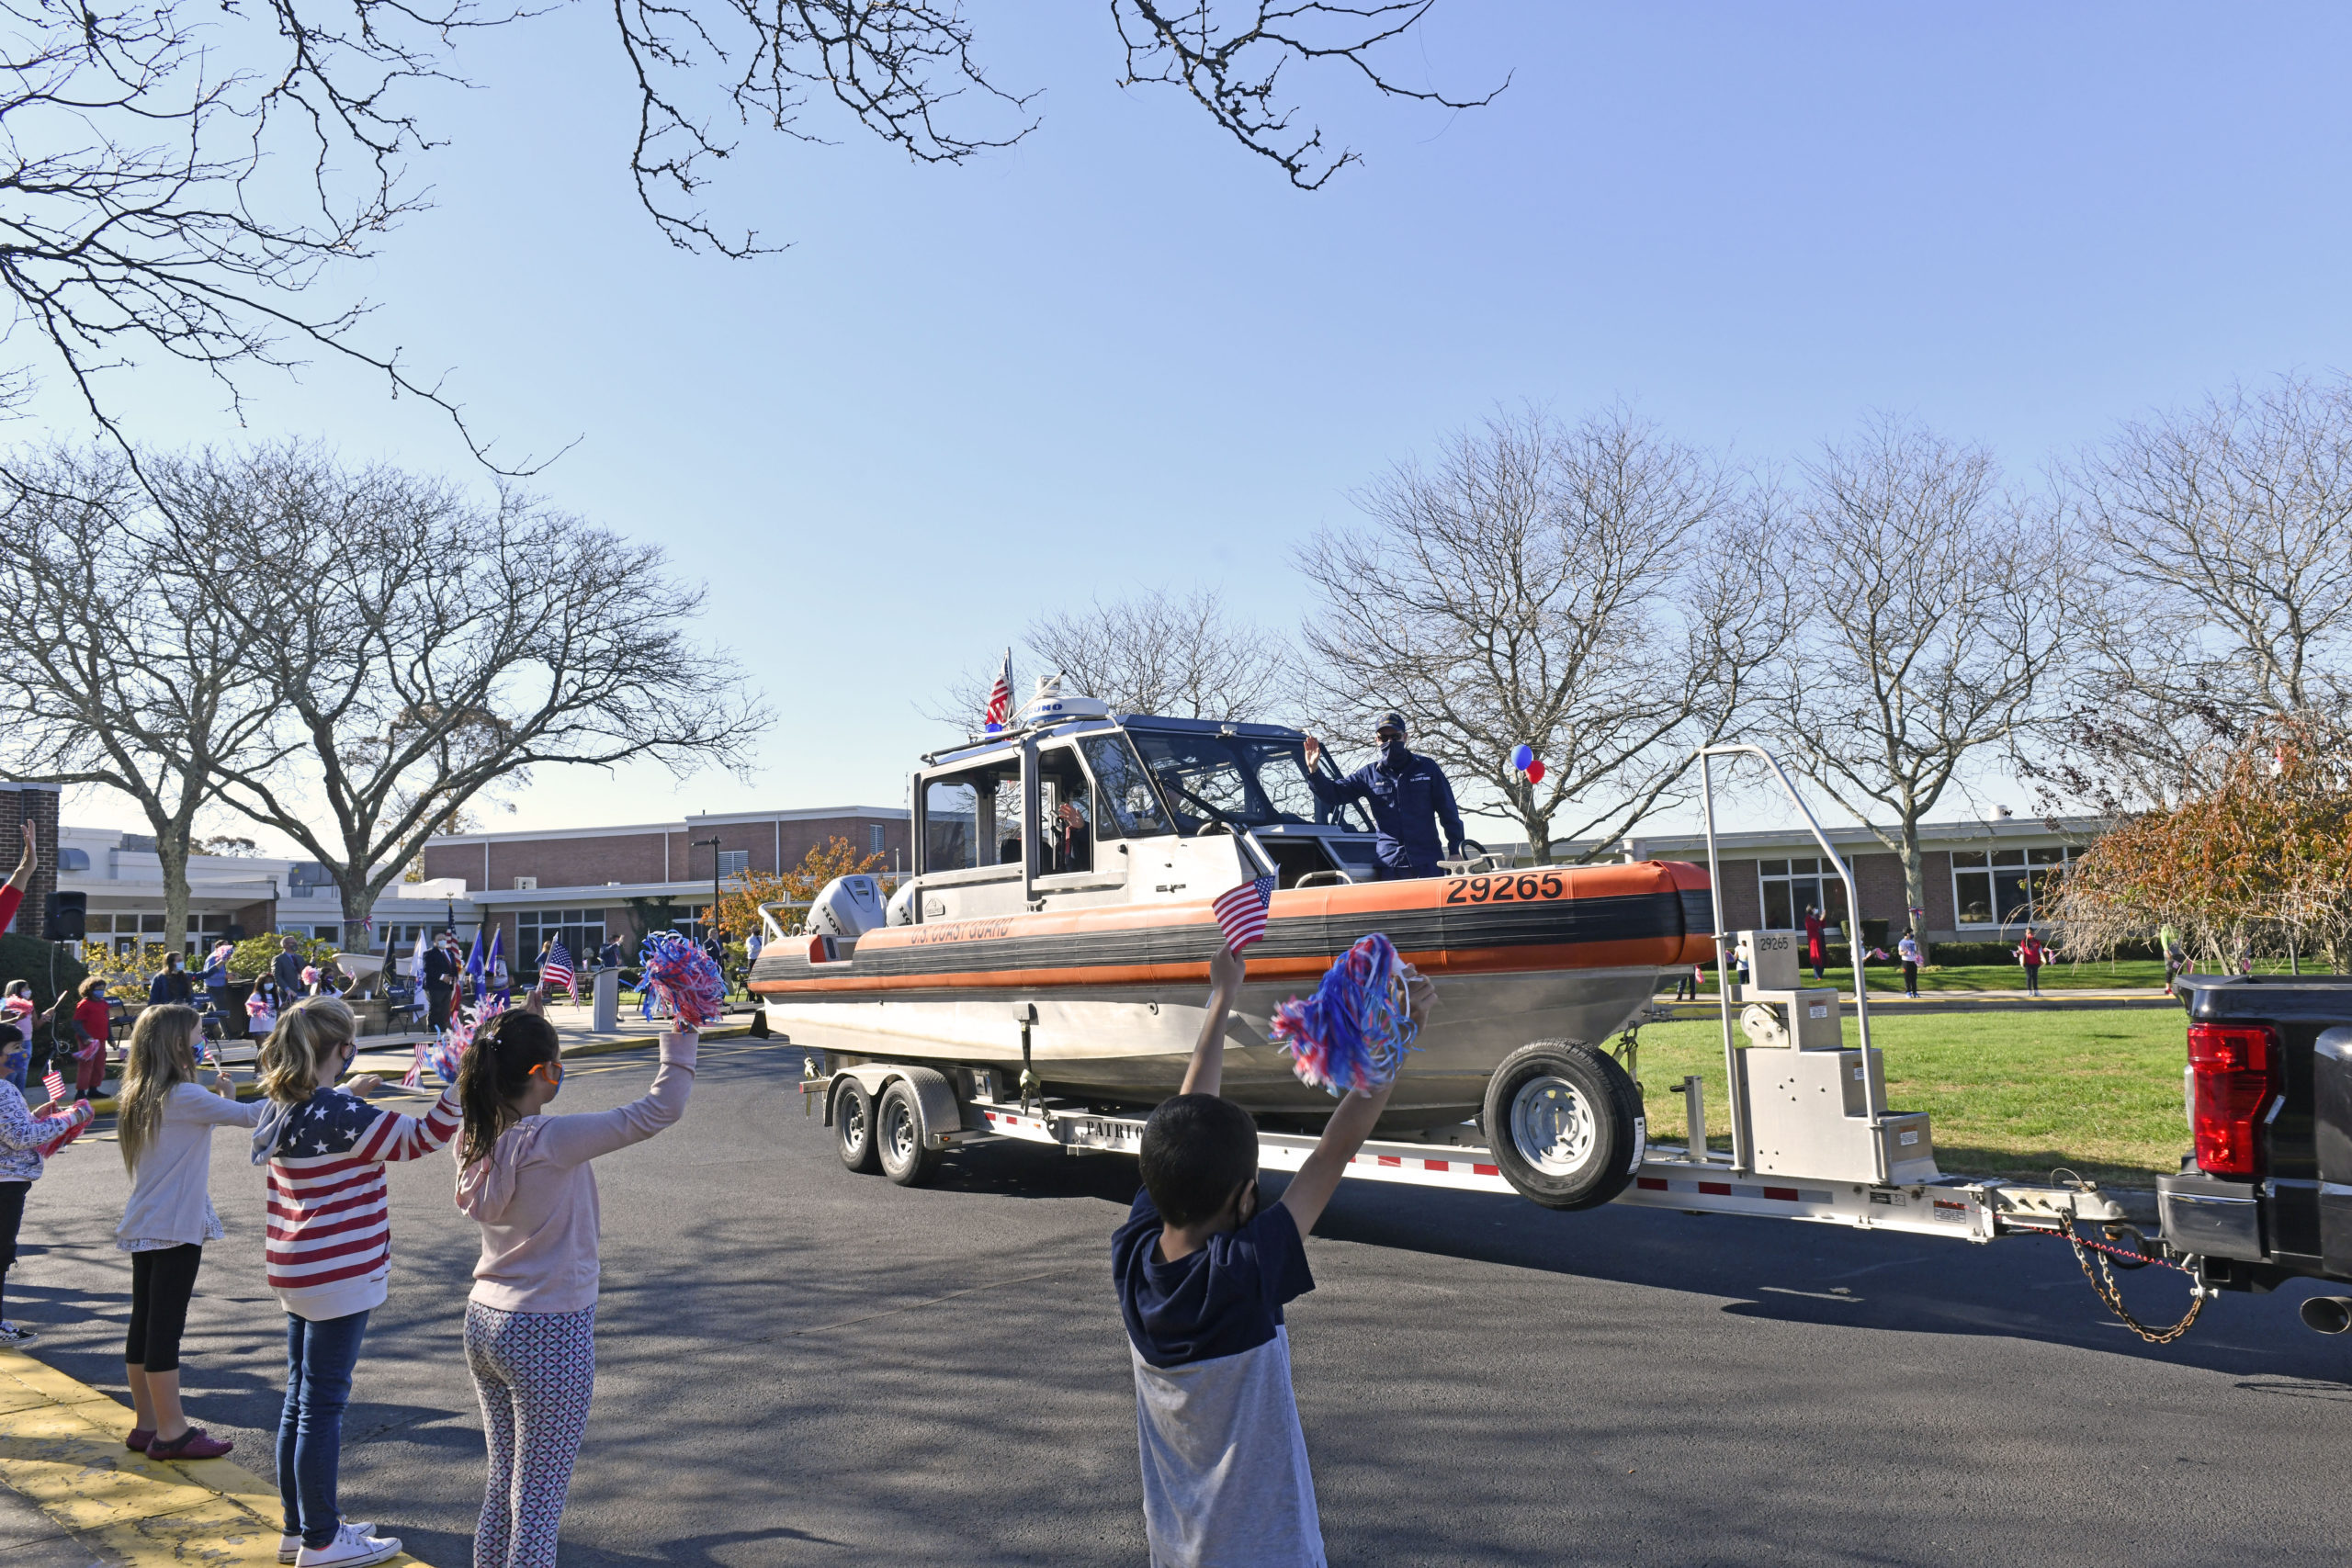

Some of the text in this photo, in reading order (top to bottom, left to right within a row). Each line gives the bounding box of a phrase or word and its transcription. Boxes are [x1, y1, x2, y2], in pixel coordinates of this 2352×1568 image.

[1446, 872, 1563, 904] 29265
[911, 918, 1014, 944] U.S. COAST GUARD
[1759, 937, 1789, 951] 29265
[1086, 1121, 1144, 1139] PATRIO
